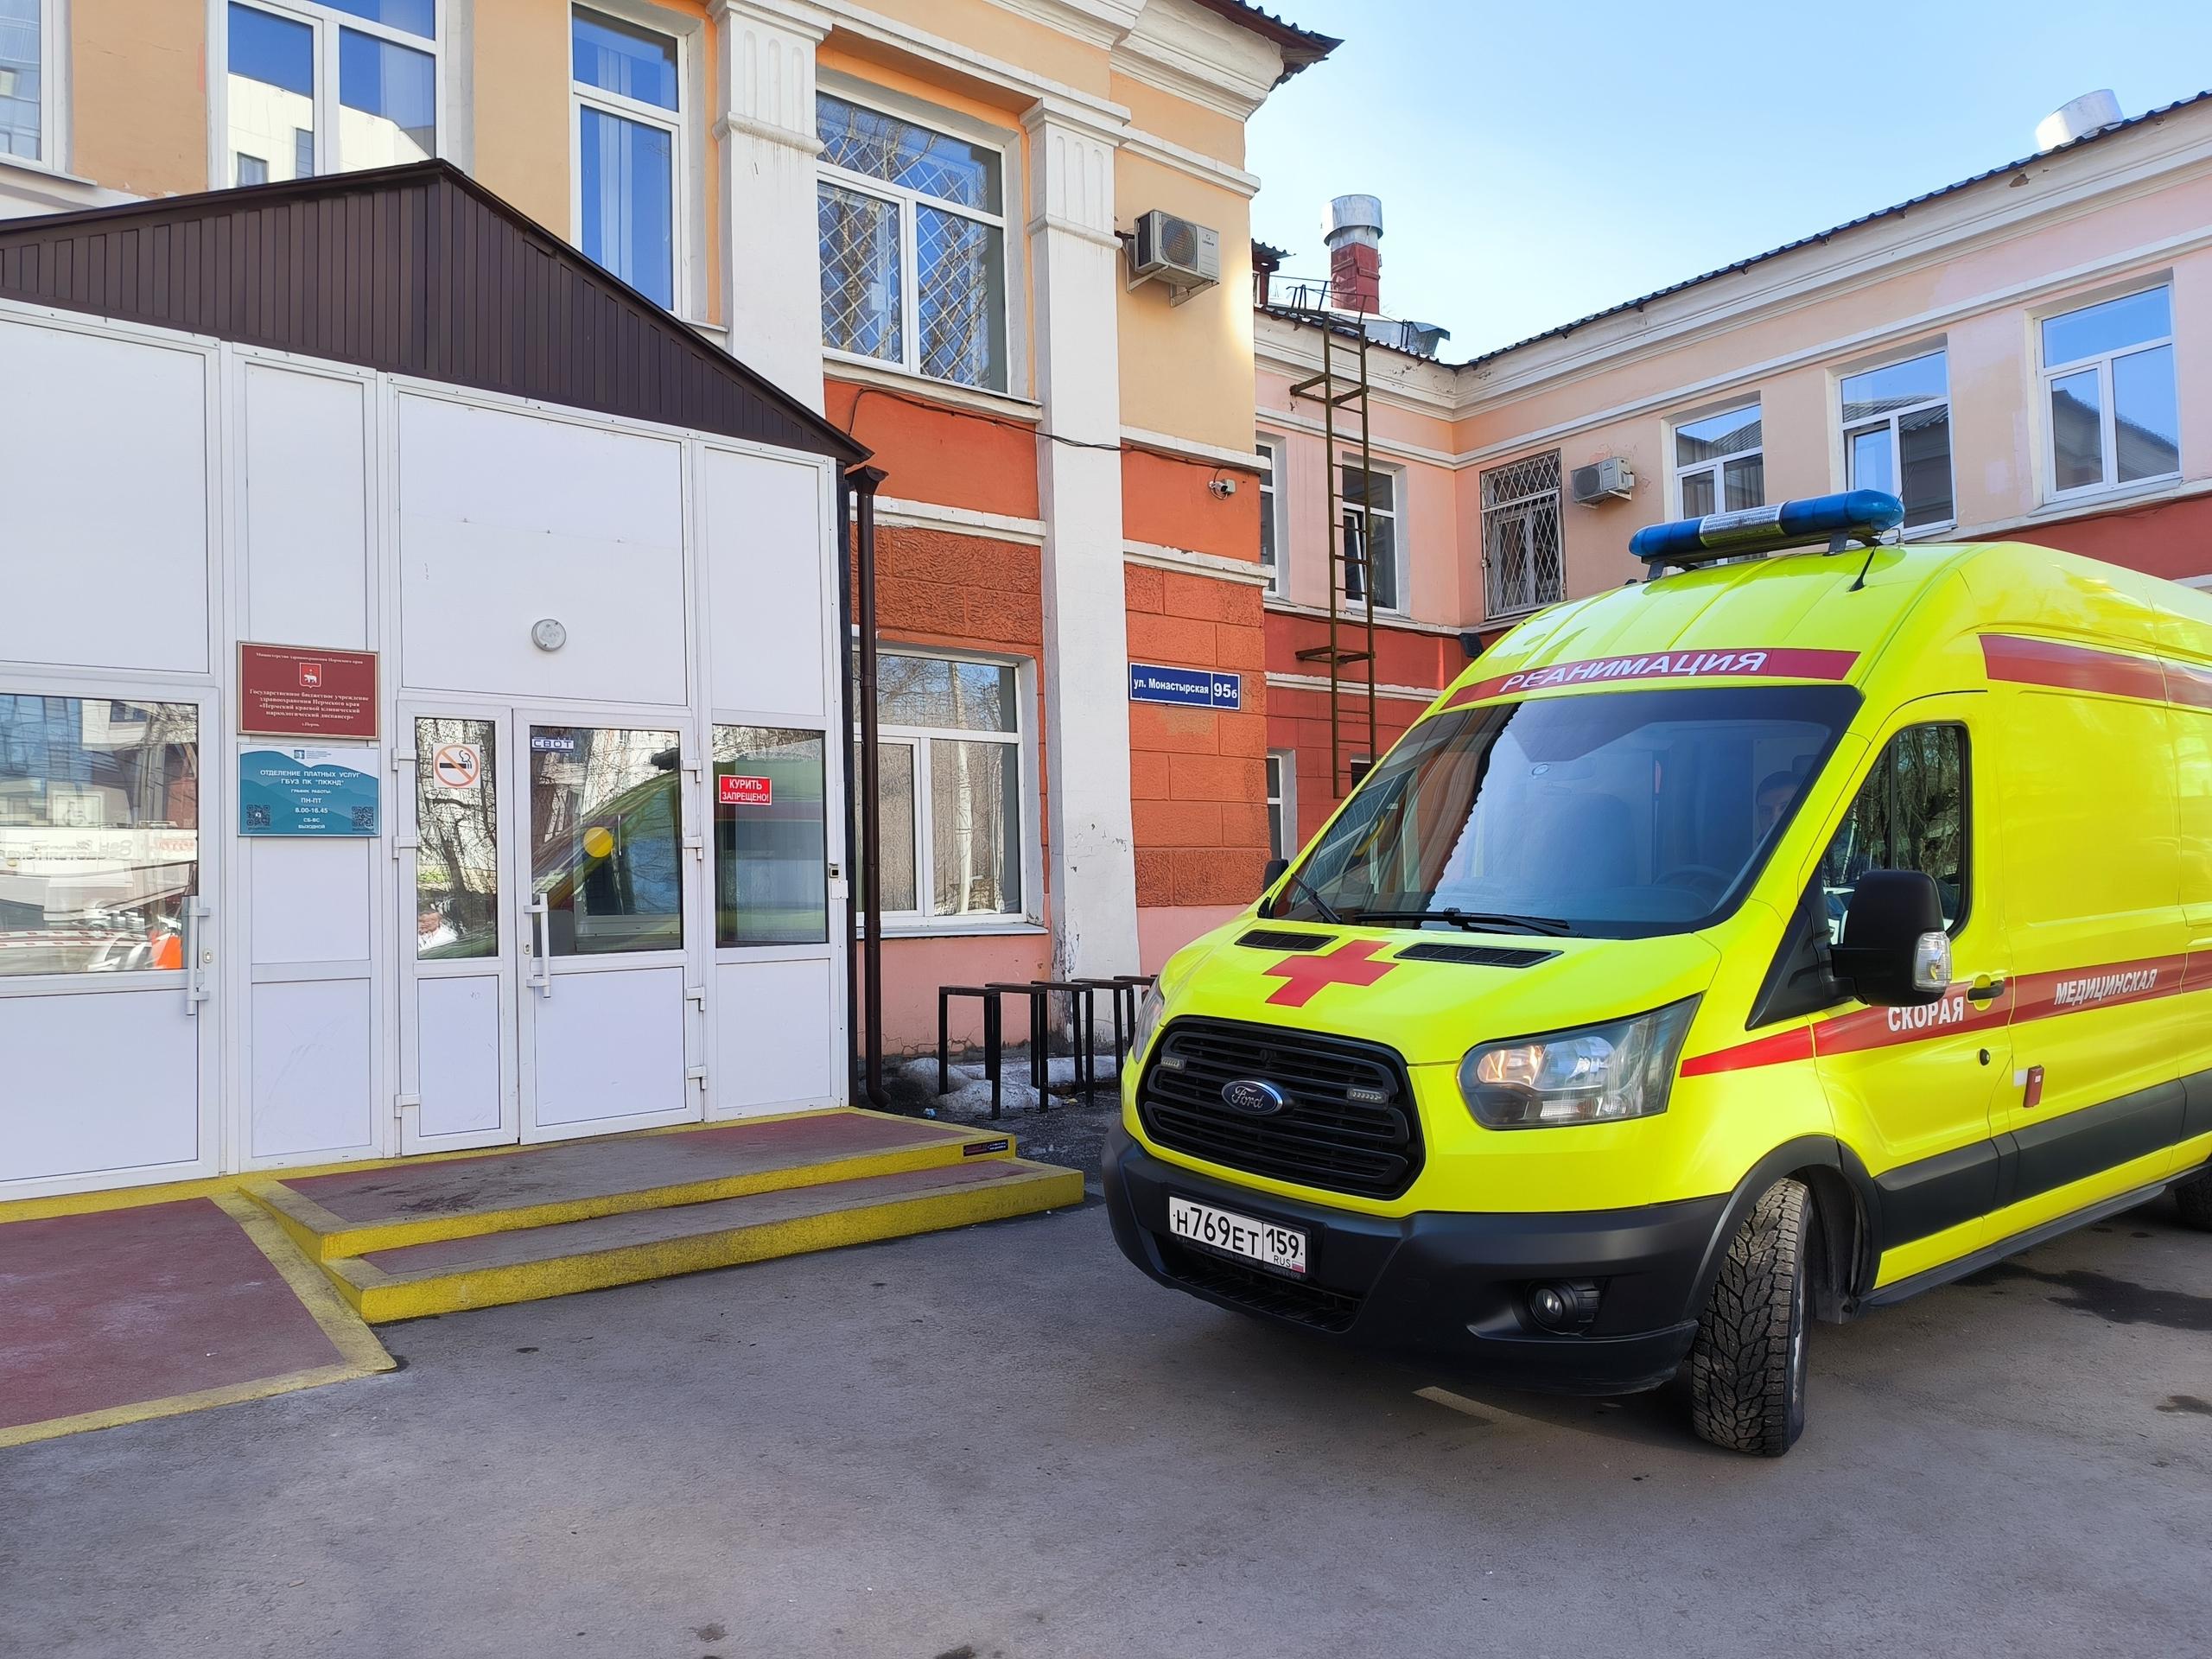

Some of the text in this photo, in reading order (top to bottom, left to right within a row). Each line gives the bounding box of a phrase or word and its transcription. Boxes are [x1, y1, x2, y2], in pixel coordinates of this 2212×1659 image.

[1499, 652, 1768, 692] РЕАНИМАЦИЯ
[250, 689, 301, 698] Государственное
[301, 691, 334, 700] бюджетное
[1134, 678, 1237, 698] ул. Монастырская 95б
[260, 696, 312, 705] здравоохранения
[312, 699, 345, 708] Пермского
[266, 710, 320, 719] наркологический
[729, 779, 762, 790] КУРИТЬ
[721, 791, 769, 802] ЗАПРЕЩЕНО!
[2054, 969, 2158, 1006] МЕДИЦИНСКАЯ
[1888, 996, 1964, 1032] СКОРАЯ
[1231, 1085, 1265, 1109] Ford
[1266, 1229, 1300, 1258] 159
[1274, 1255, 1291, 1268] RUS
